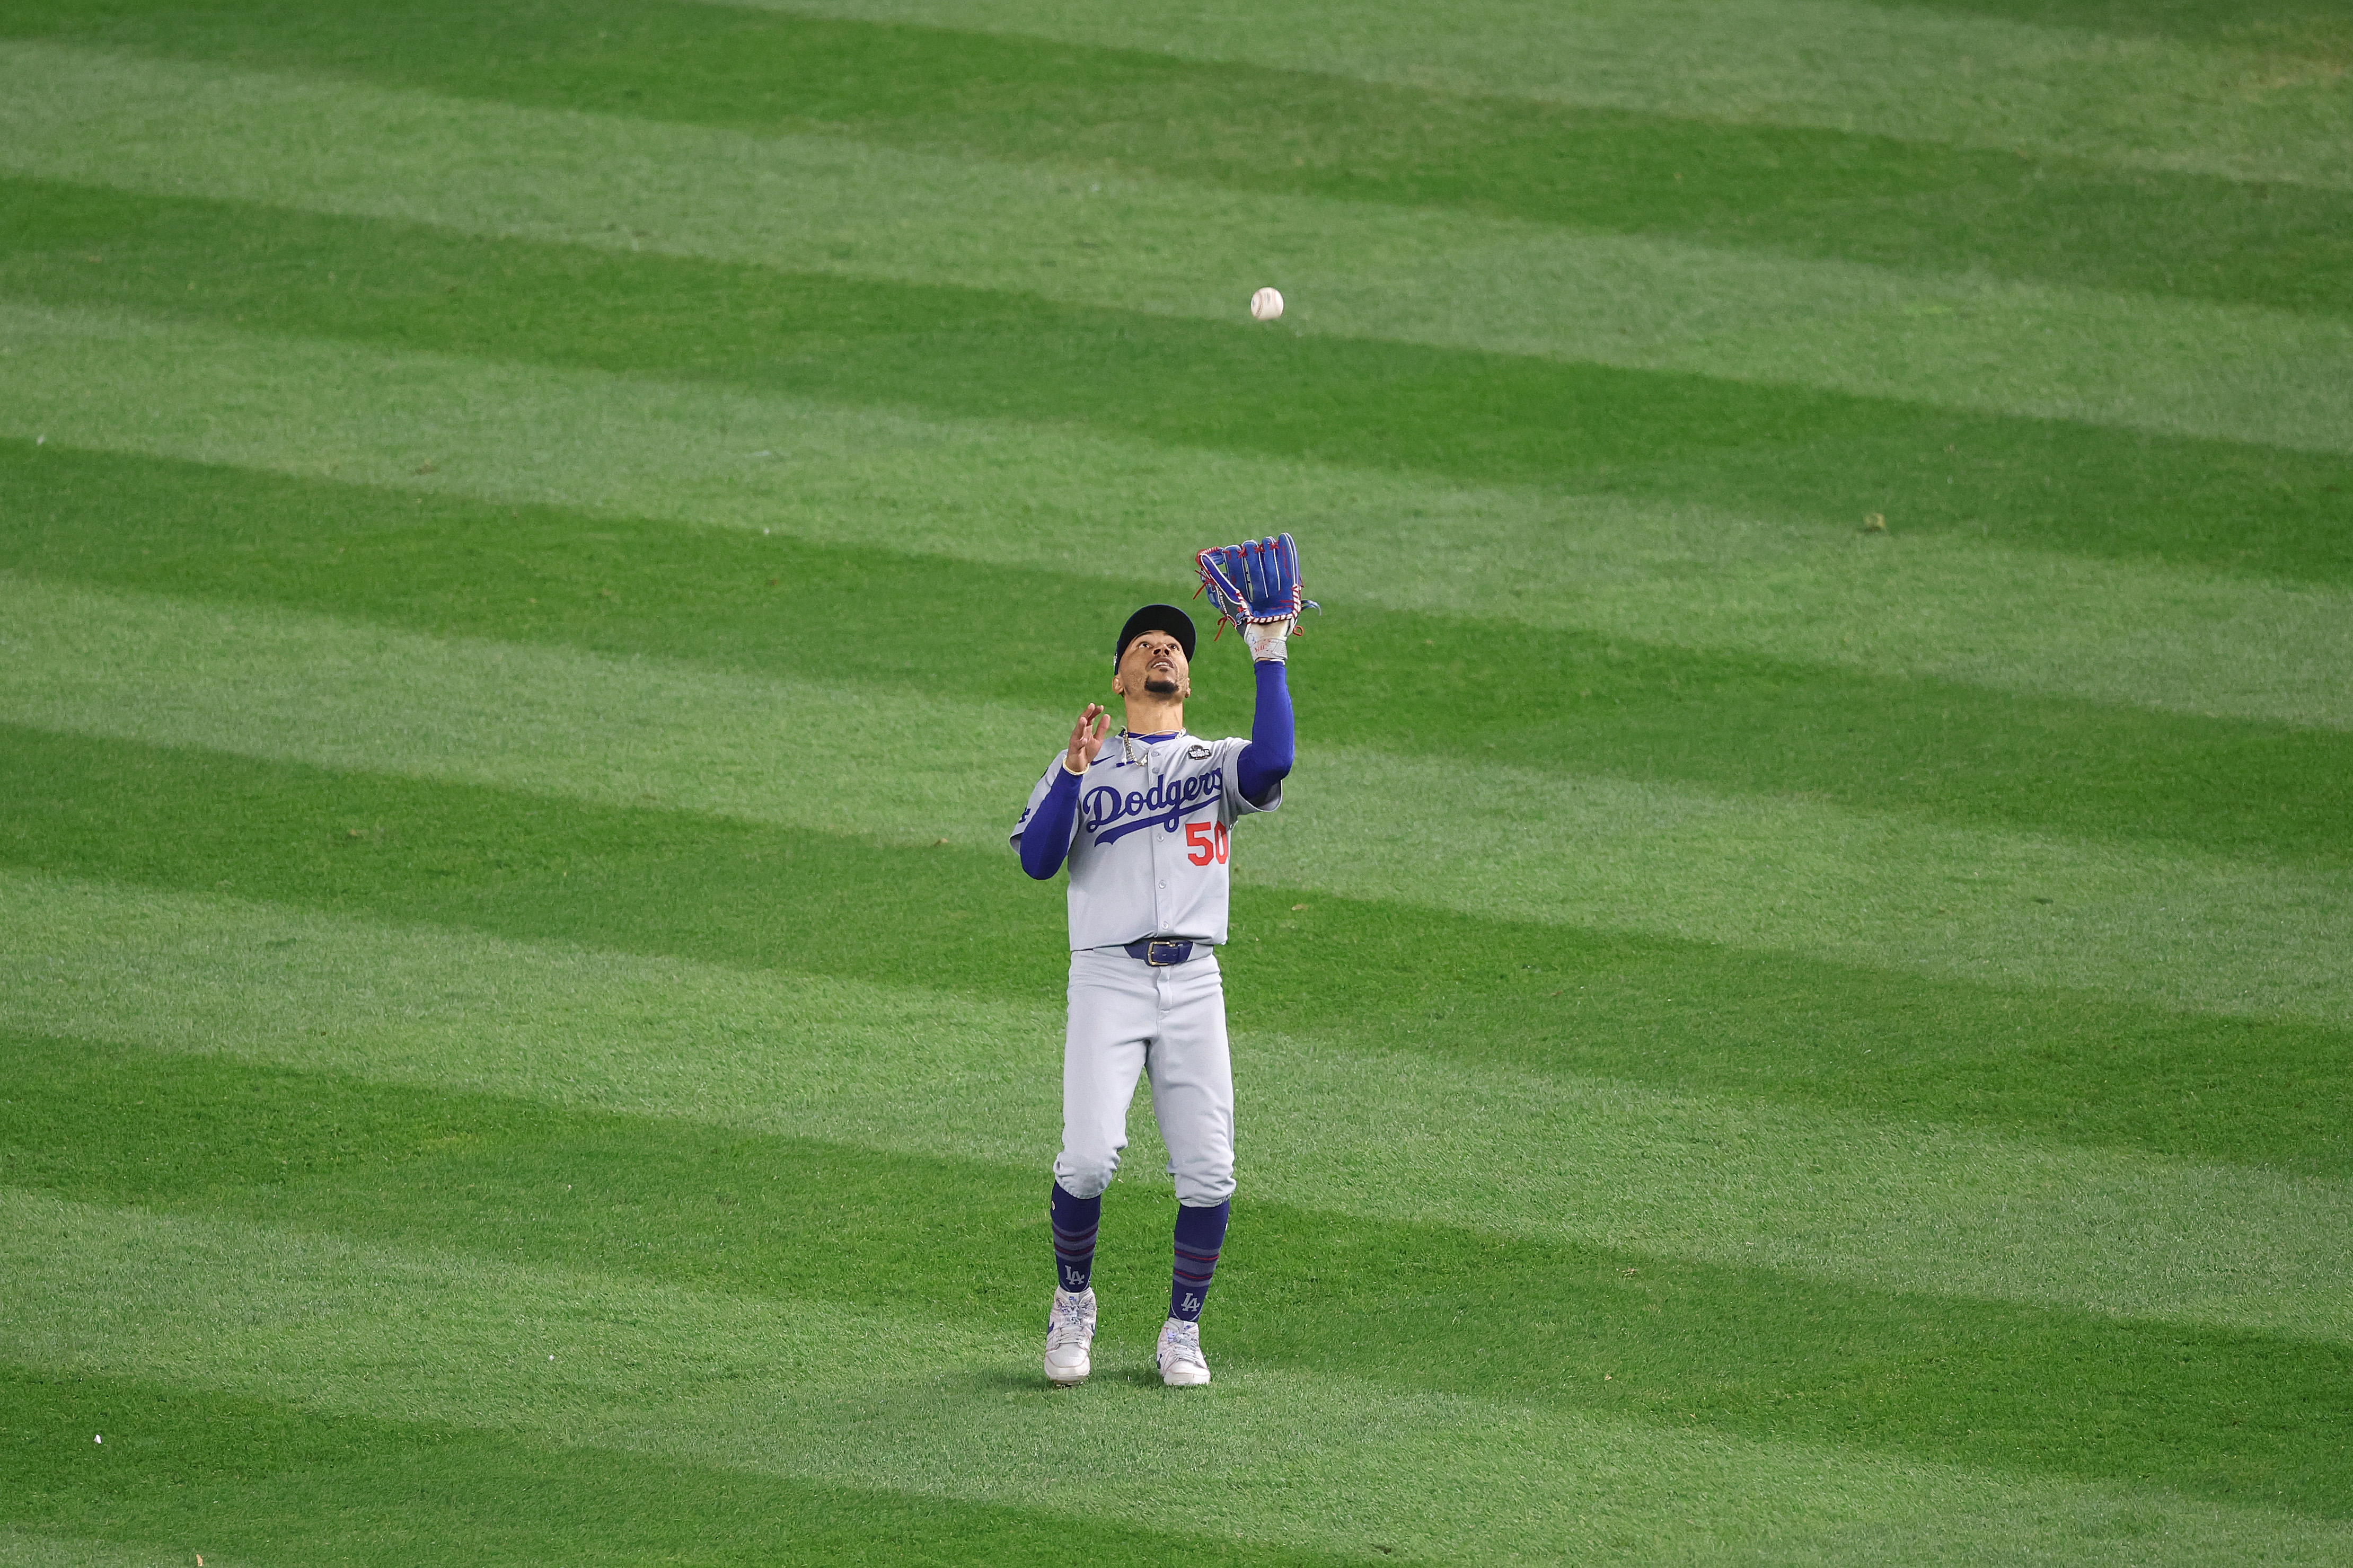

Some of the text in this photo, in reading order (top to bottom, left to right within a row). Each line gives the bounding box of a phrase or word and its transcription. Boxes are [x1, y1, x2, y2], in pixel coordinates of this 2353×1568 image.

[1082, 767, 1222, 833] Dodgers
[1185, 821, 1228, 866] 50
[1065, 1265, 1085, 1284] LA
[1181, 1292, 1200, 1312] LA
